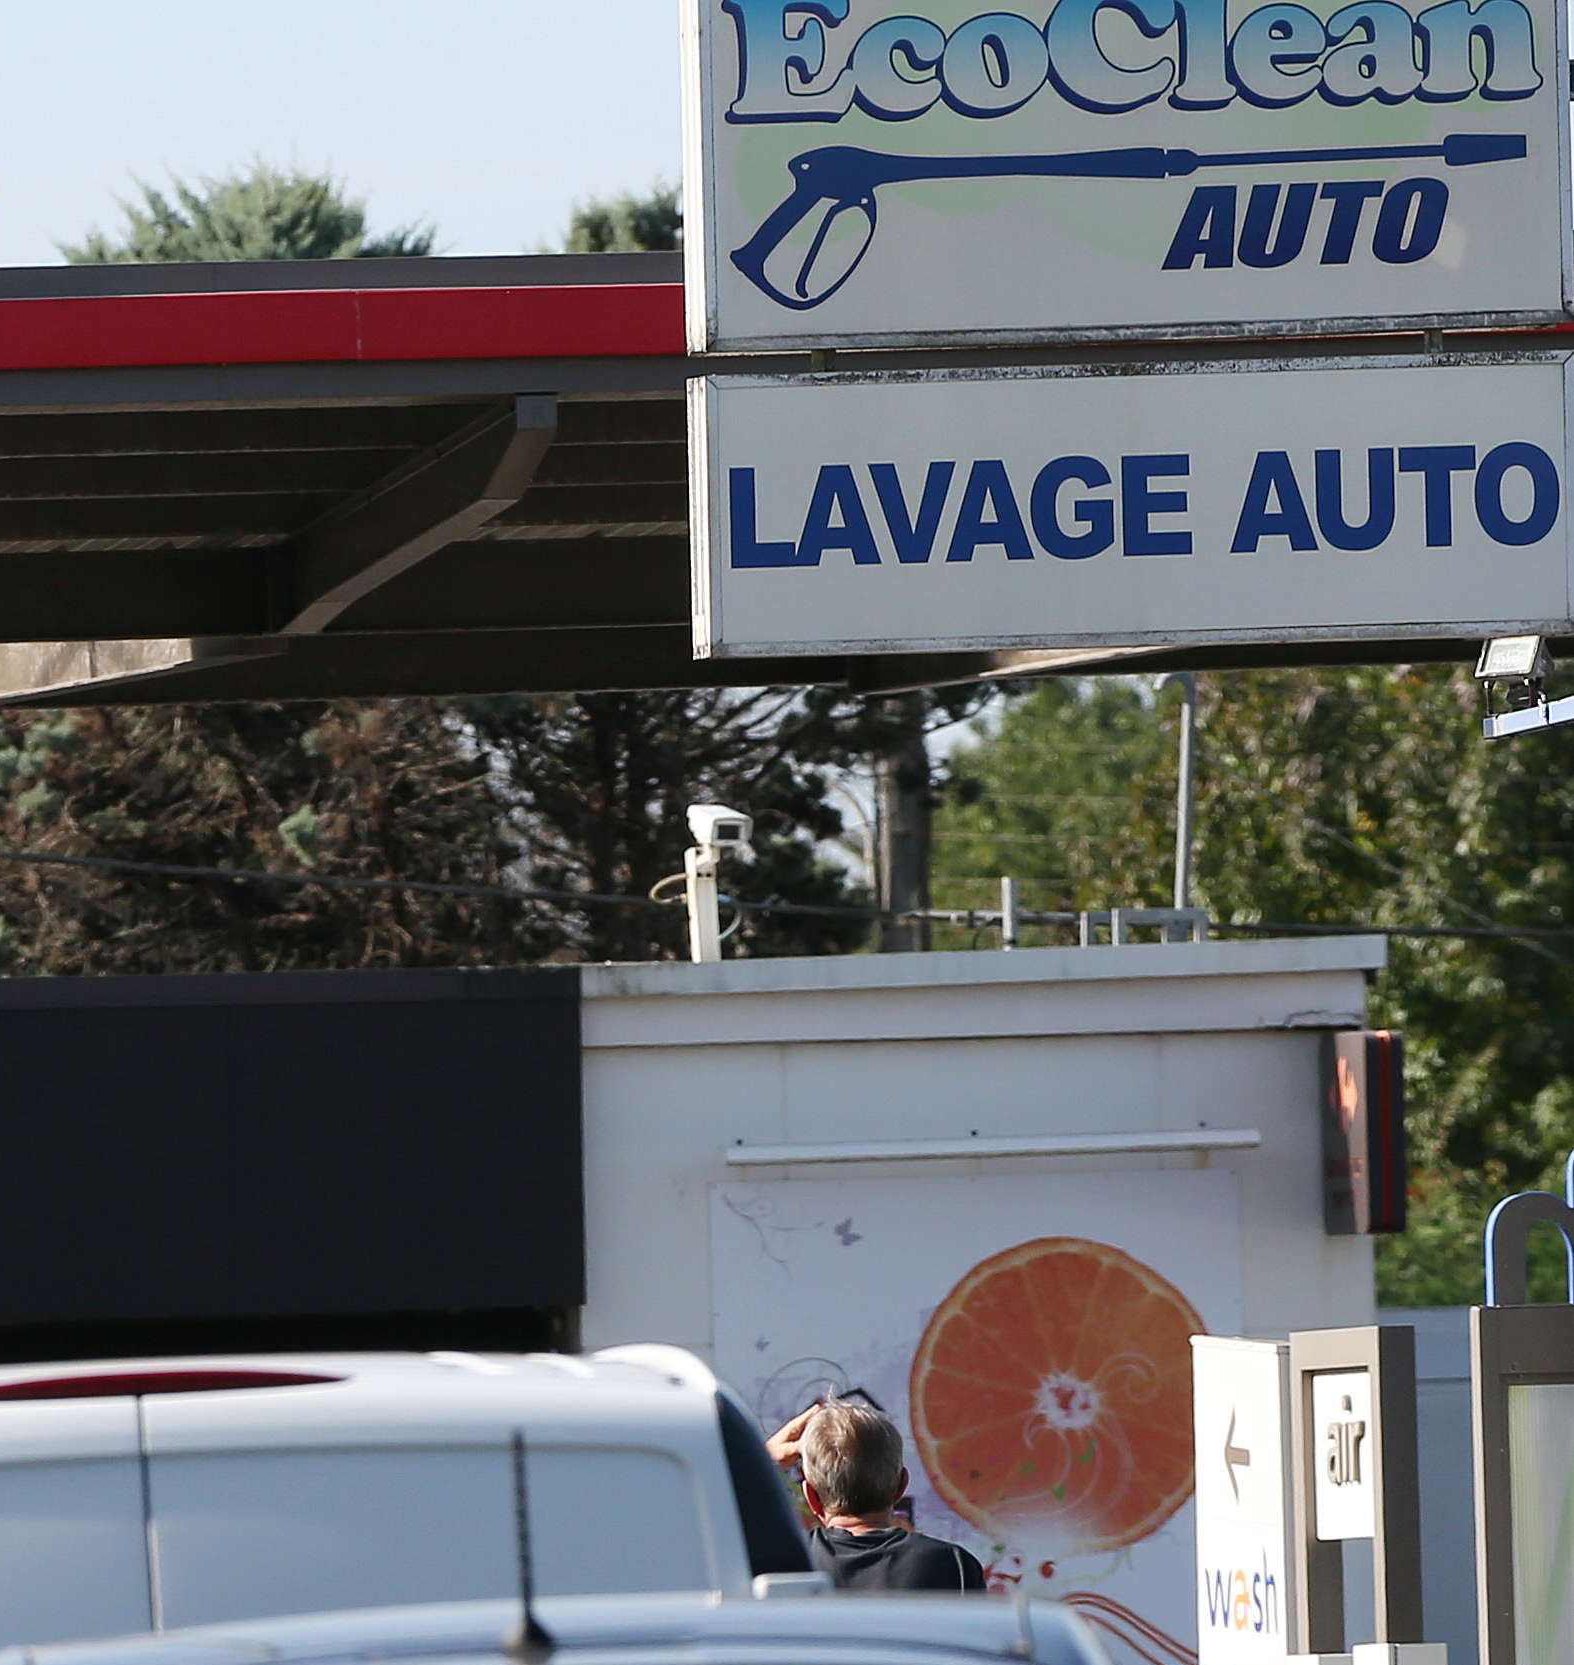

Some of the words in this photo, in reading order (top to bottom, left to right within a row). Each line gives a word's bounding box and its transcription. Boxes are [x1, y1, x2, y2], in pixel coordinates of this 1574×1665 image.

[724, 0, 1544, 124] EcoClean
[1162, 177, 1450, 271] AUTO
[729, 452, 1193, 570] LAVAGE
[1229, 441, 1561, 553] AUTO
[1327, 1394, 1366, 1487] air
[1205, 1546, 1279, 1635] wash
